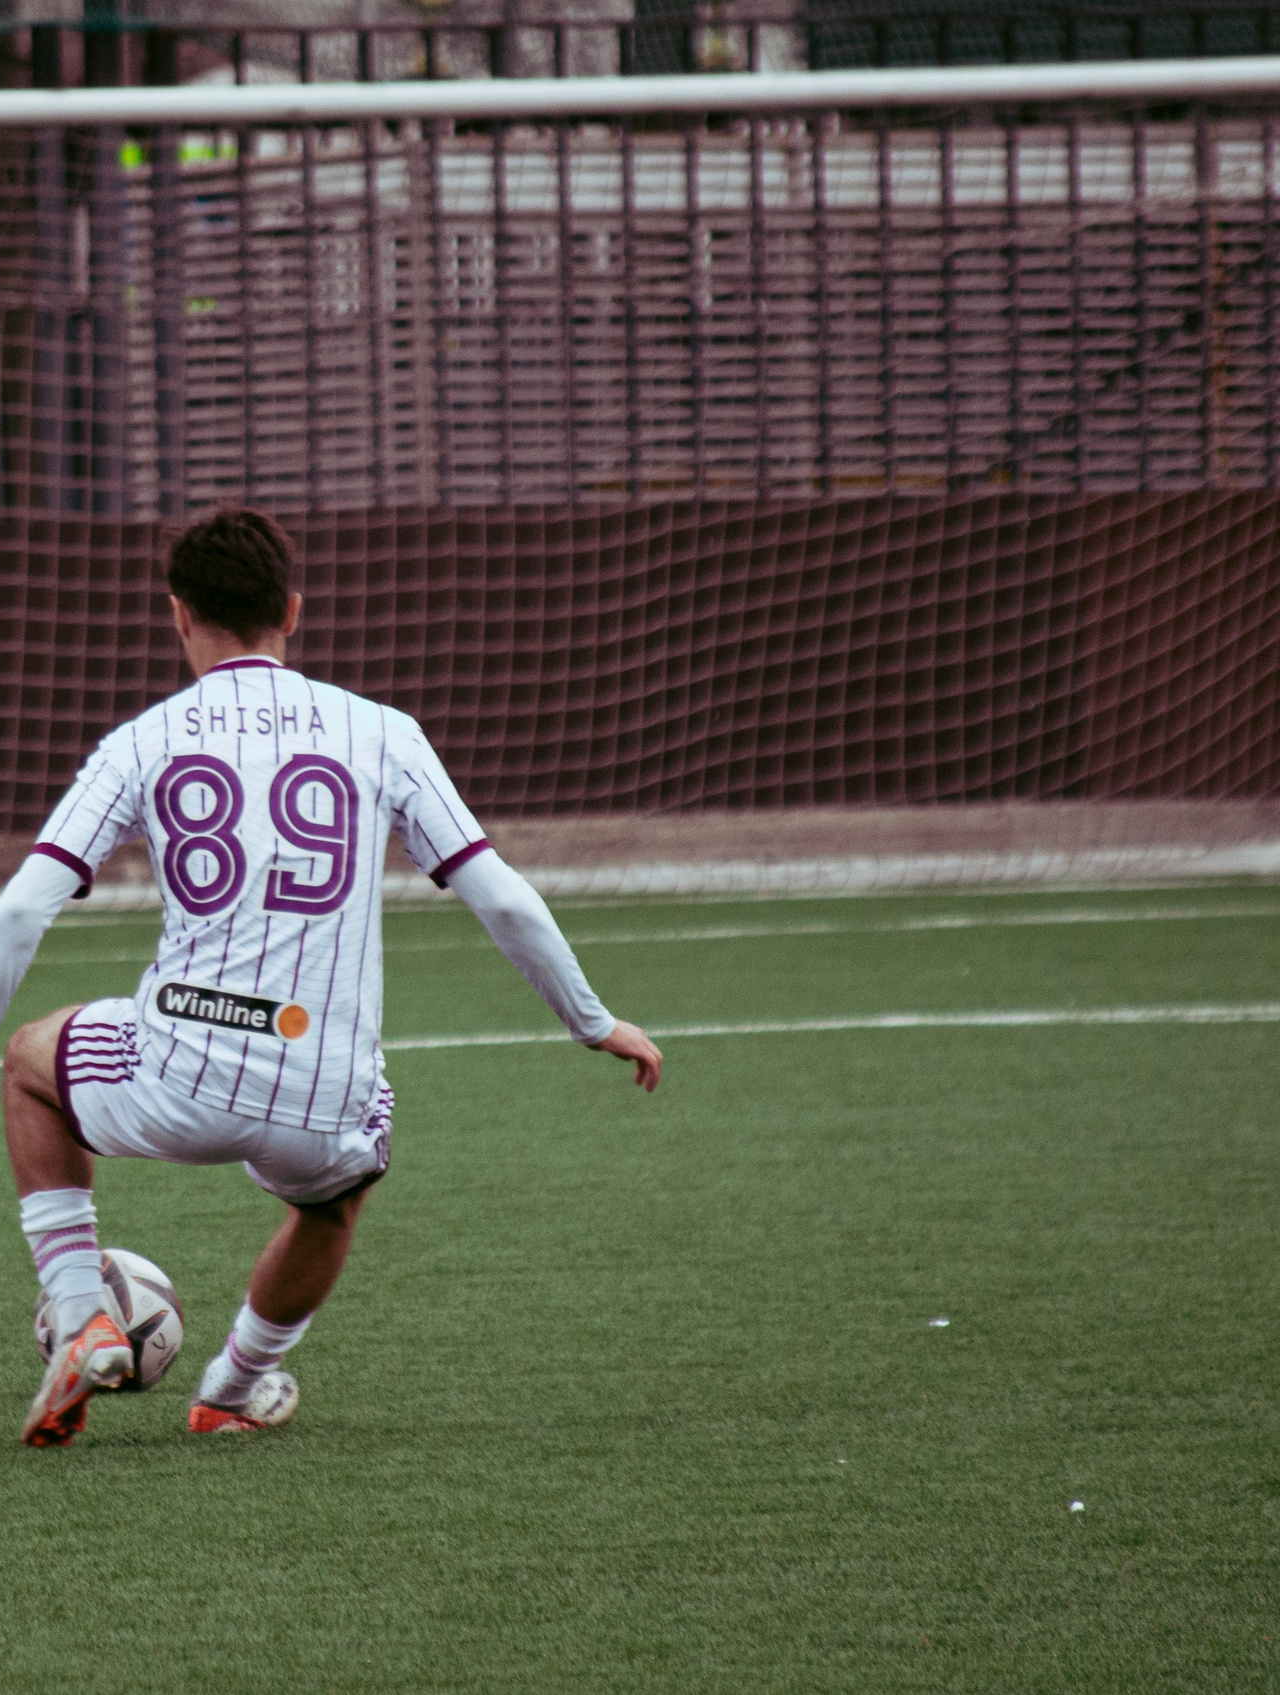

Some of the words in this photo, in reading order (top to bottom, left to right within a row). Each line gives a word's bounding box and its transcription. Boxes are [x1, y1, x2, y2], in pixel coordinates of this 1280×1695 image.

[185, 705, 327, 736] SHISHA
[154, 753, 360, 917] 89
[166, 988, 268, 1028] Winline
